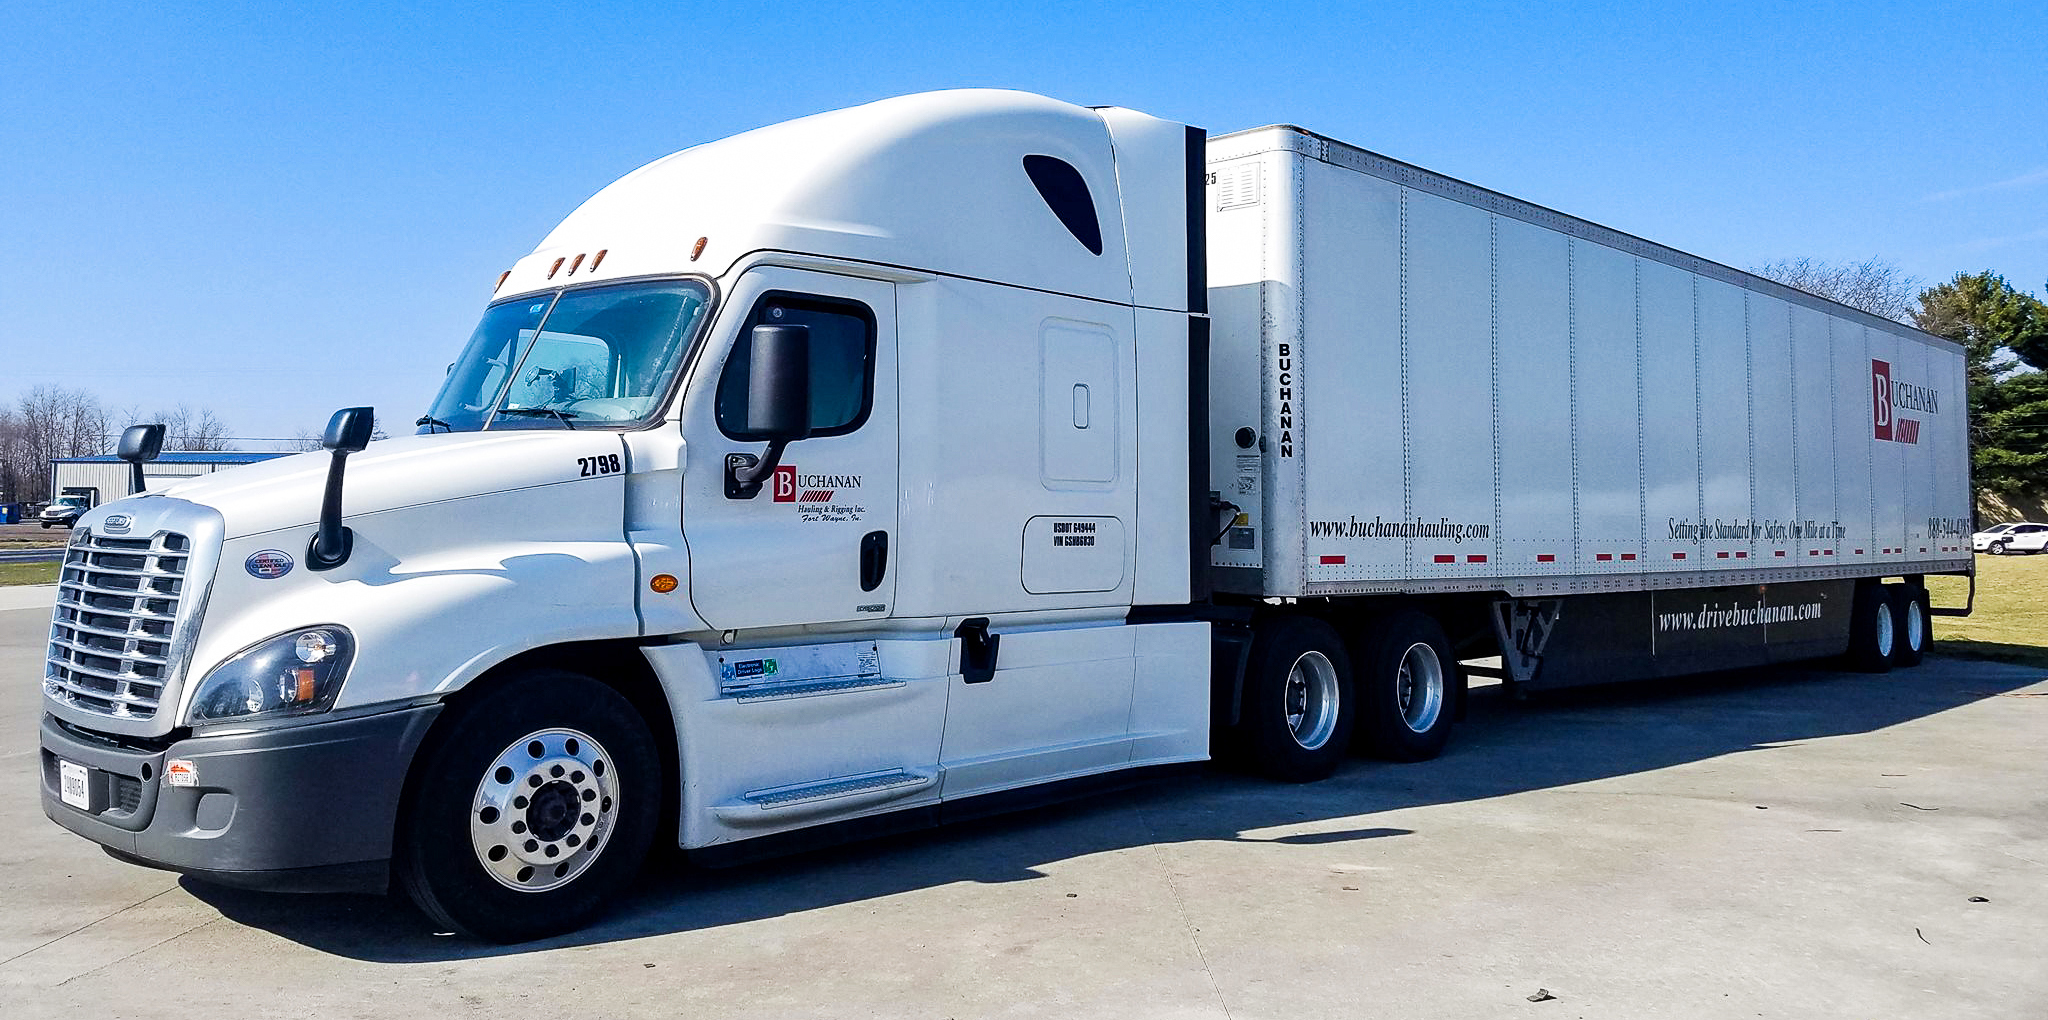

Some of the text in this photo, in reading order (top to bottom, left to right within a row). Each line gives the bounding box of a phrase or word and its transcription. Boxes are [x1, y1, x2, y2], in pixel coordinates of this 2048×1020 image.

[1279, 343, 1293, 458] BUCHANAN
[1875, 373, 1938, 427] BUCHANAN
[577, 453, 621, 477] 2798
[777, 471, 862, 497] BUCHANAN
[798, 505, 823, 515] Hauling
[801, 514, 819, 523] Fort
[1309, 515, 1490, 544] www.buchananhauling.com
[1668, 517, 1698, 545] Setting
[1714, 518, 1750, 540] Standard
[1803, 520, 1817, 539] Mile
[1659, 600, 1821, 632] www.drivebuchanan.com
